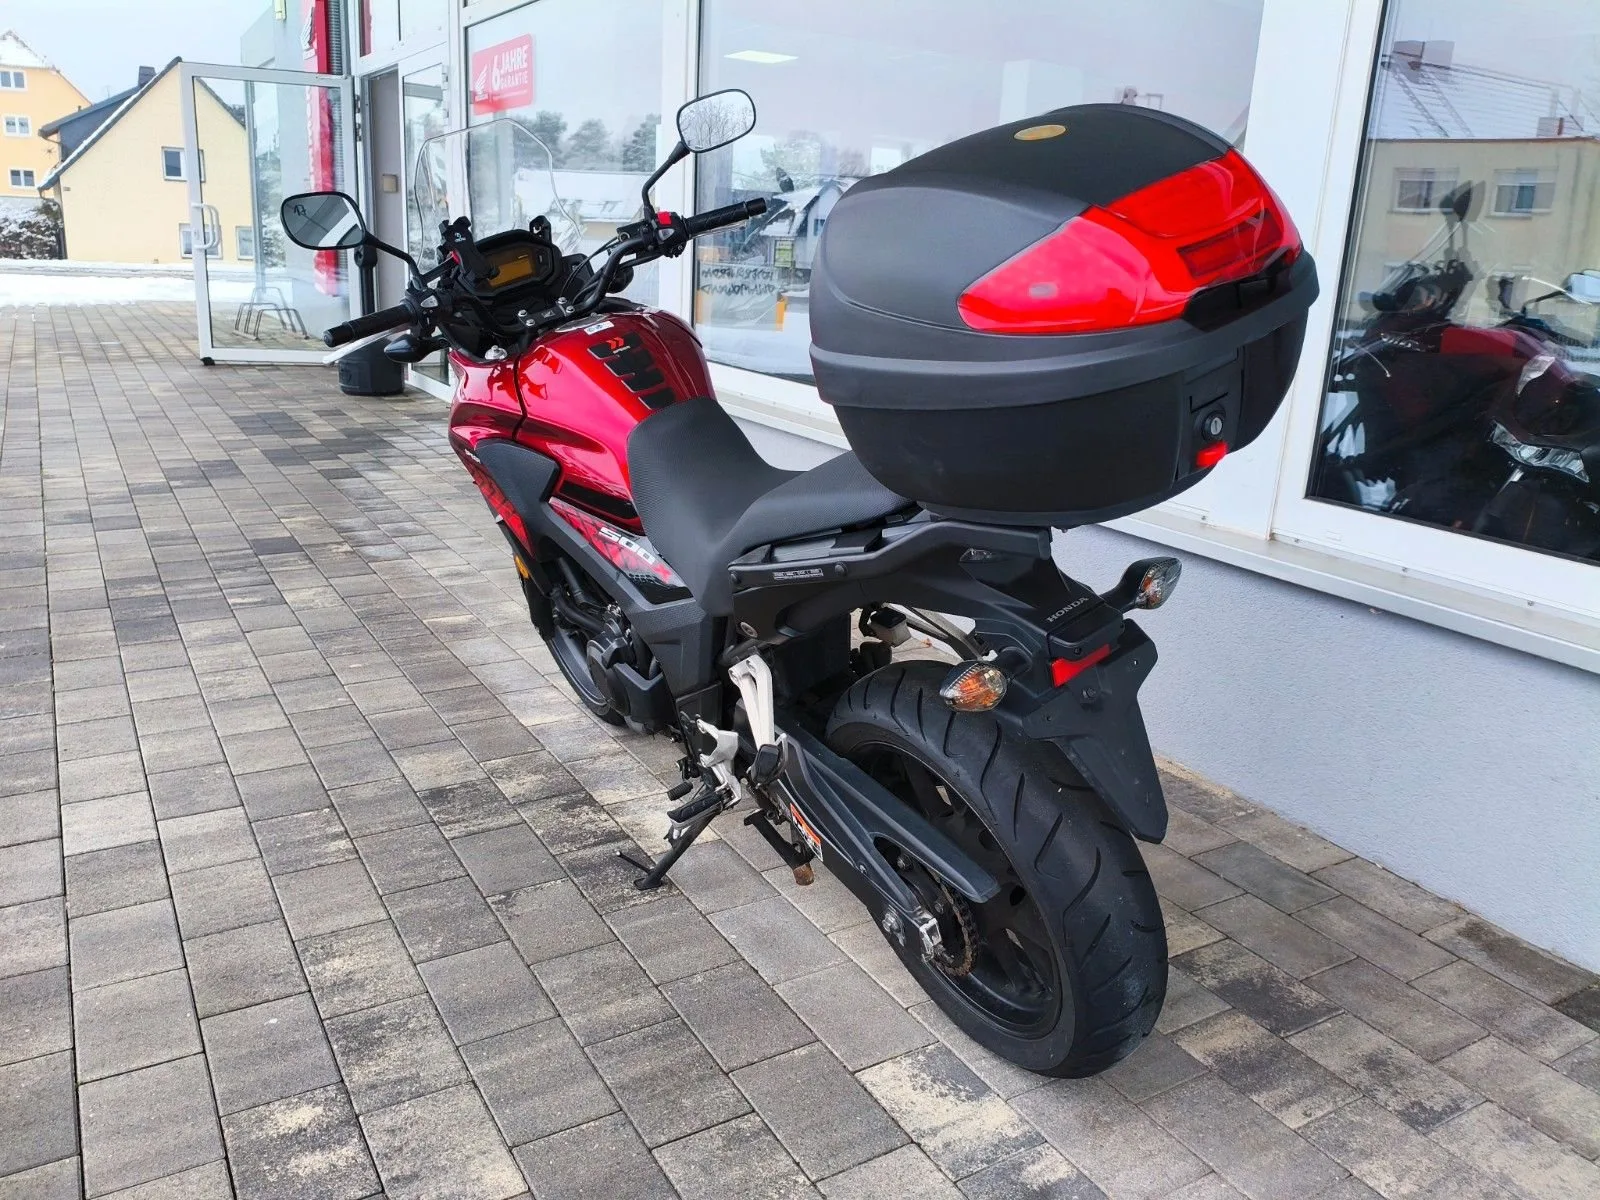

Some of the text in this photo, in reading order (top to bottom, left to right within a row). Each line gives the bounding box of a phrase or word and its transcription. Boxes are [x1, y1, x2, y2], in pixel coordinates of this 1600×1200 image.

[491, 43, 530, 92] 6 JAHRE
[1046, 597, 1089, 622] HONDA
